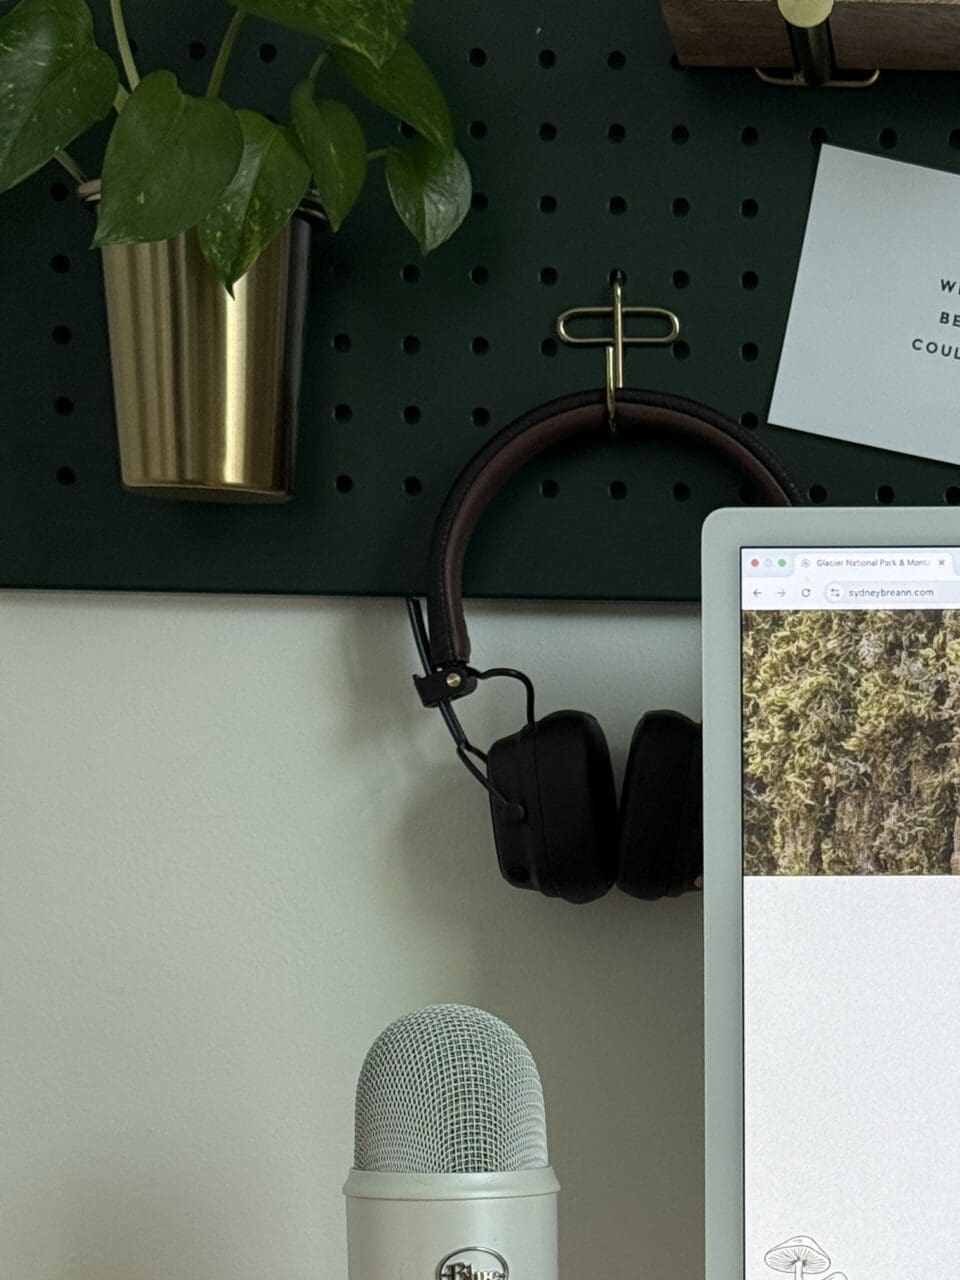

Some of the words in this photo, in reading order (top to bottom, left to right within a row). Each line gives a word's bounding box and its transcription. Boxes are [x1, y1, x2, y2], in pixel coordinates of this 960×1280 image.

[817, 559, 844, 567] Glacier
[846, 559, 878, 567] National
[880, 559, 896, 567] Park
[899, 559, 905, 567] &
[848, 588, 934, 598] sydneybreann.com
